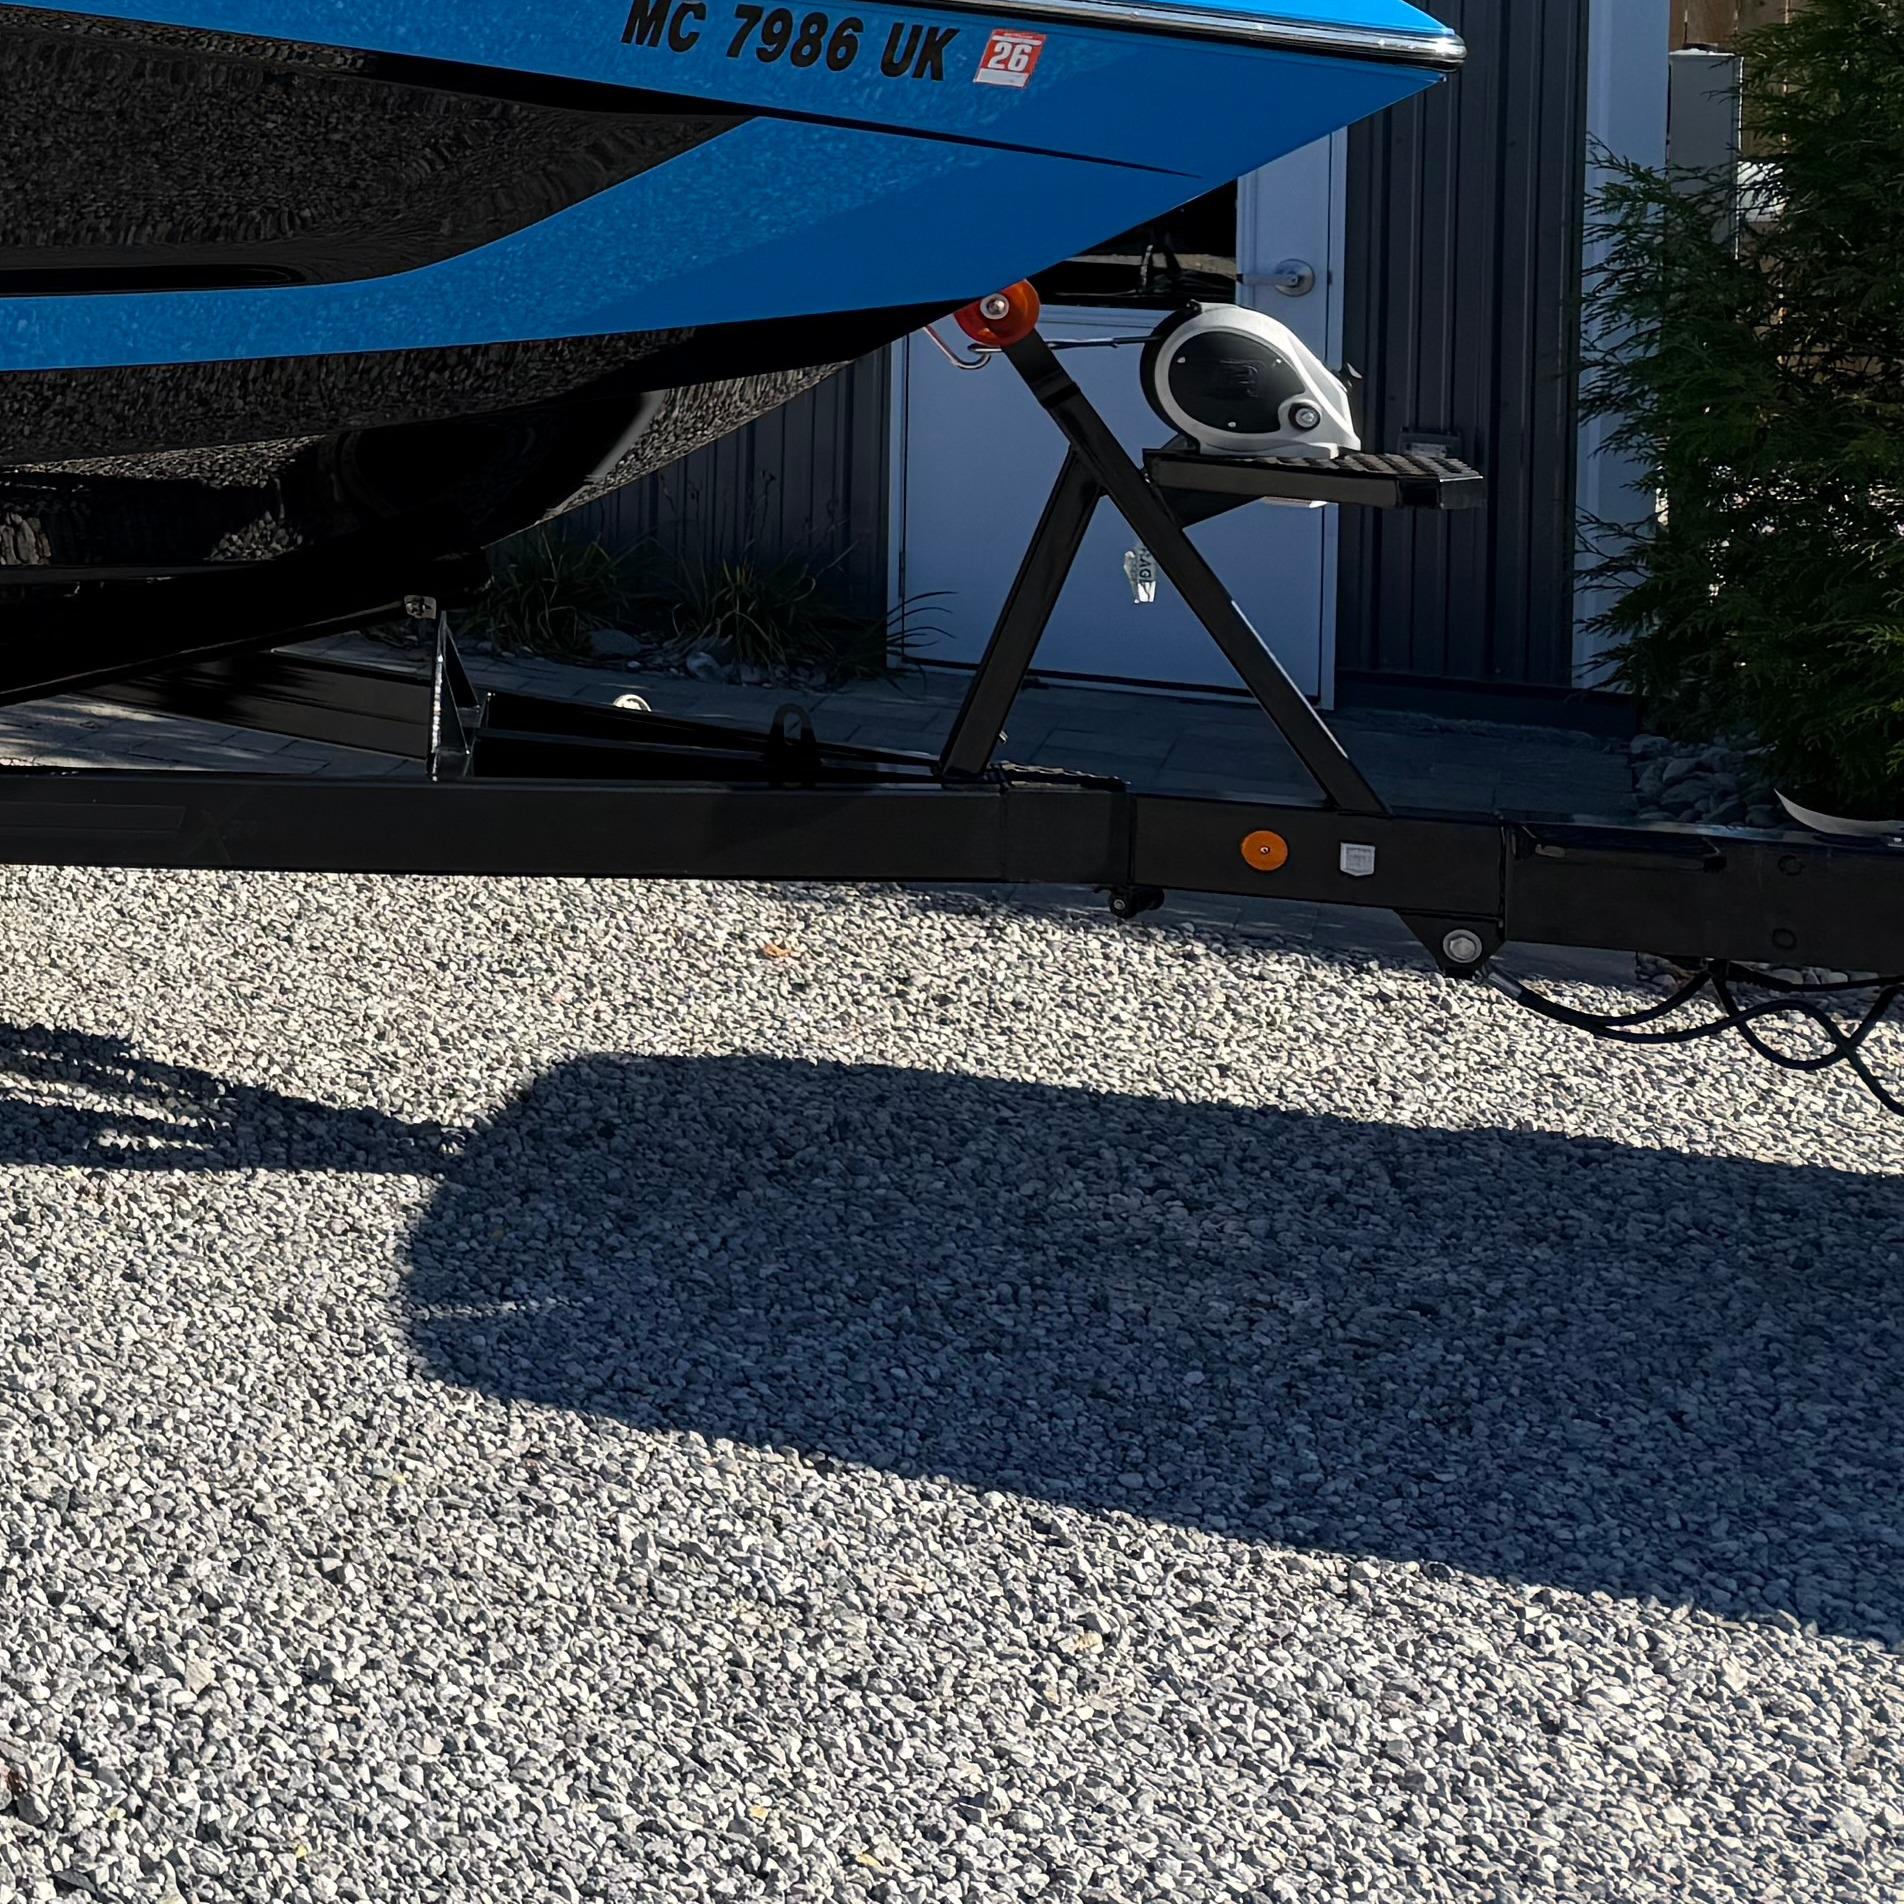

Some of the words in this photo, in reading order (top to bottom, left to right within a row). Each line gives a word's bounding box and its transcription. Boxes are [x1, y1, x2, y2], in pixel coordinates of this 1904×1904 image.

[726, 3, 864, 72] 7986
[880, 22, 961, 81] UK
[987, 41, 1033, 72] 26
